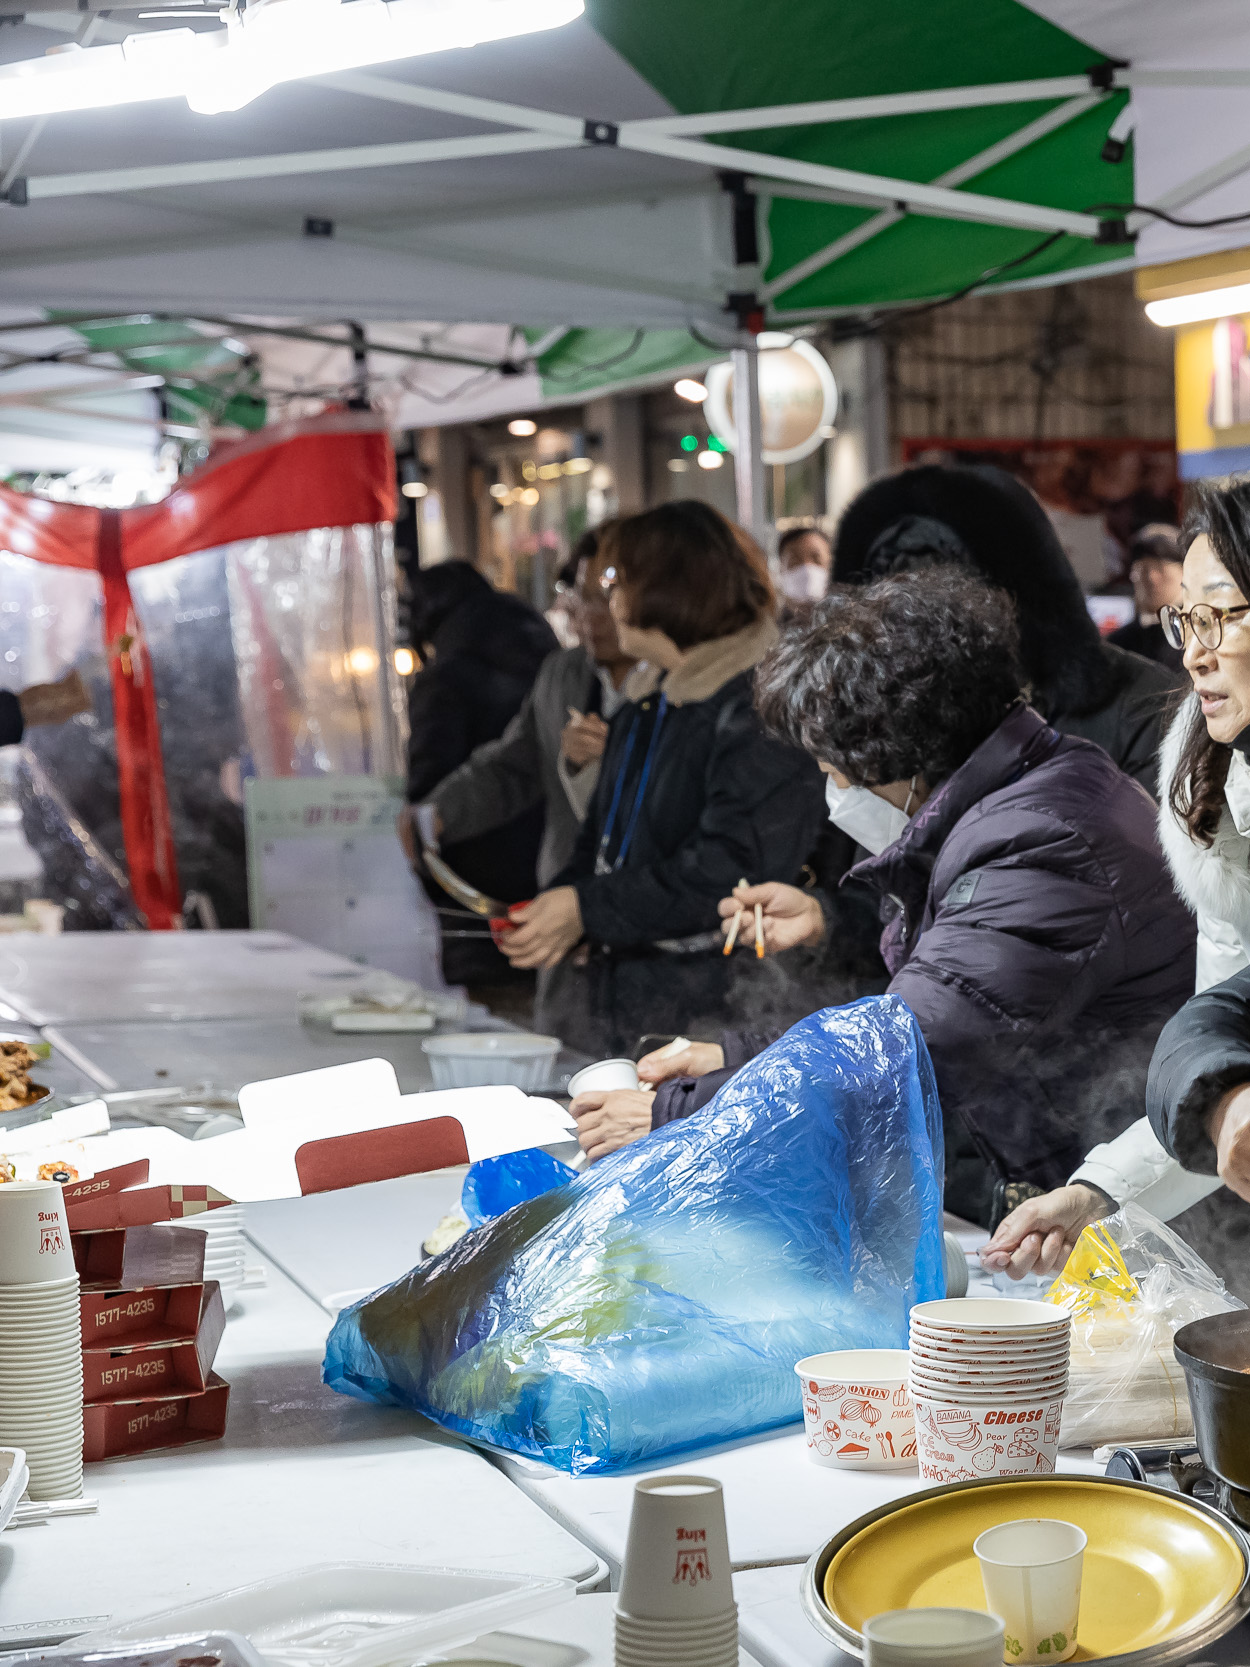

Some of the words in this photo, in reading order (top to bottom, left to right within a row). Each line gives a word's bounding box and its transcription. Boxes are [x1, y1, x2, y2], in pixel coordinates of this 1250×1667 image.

[37, 1211, 60, 1223] king
[94, 1297, 156, 1328] 1577-4235
[100, 1359, 166, 1386] 1577-4235
[848, 1385, 888, 1399] ONION
[127, 1403, 178, 1434] 1577-4235
[936, 1410, 971, 1422] BANANA
[983, 1408, 1044, 1425] Cheese
[918, 1432, 935, 1450] ICE
[986, 1432, 1007, 1441] Pear
[924, 1448, 955, 1463] cream
[676, 1527, 705, 1542] king
